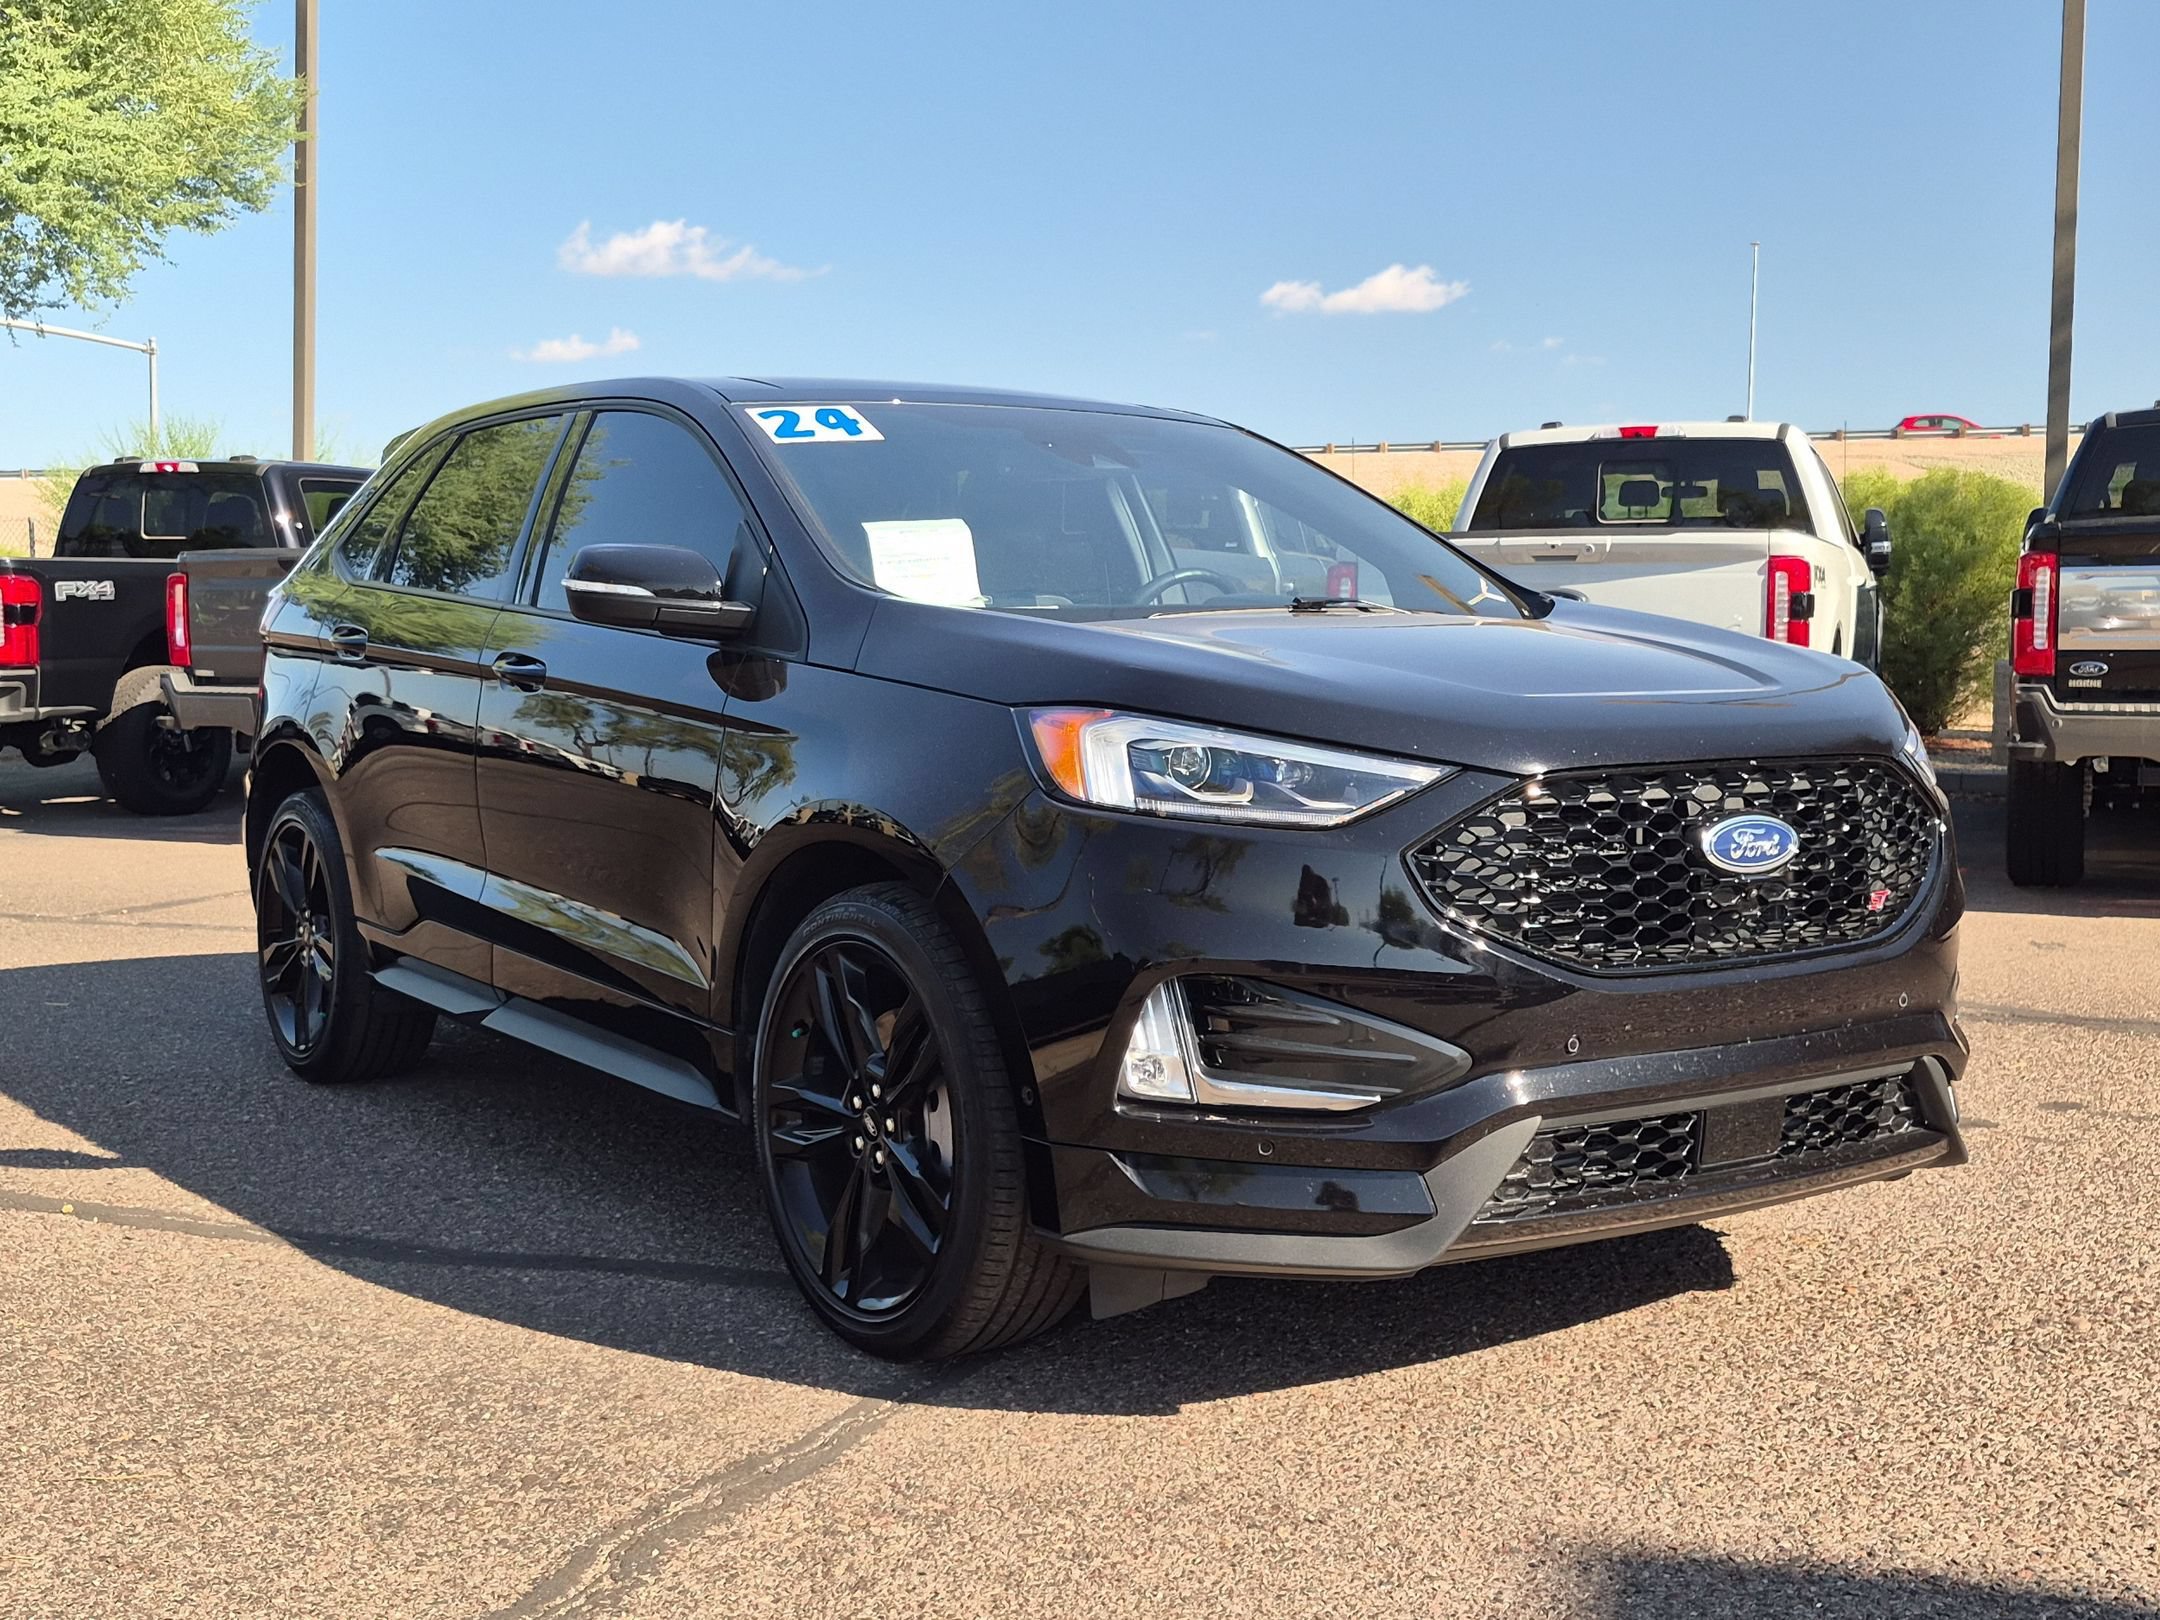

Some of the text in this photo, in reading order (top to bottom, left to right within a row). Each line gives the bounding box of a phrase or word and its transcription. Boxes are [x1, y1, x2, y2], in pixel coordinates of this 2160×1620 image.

[54, 580, 115, 601] FX4
[1730, 828, 1781, 860] Ford
[1867, 889, 1892, 912] ST
